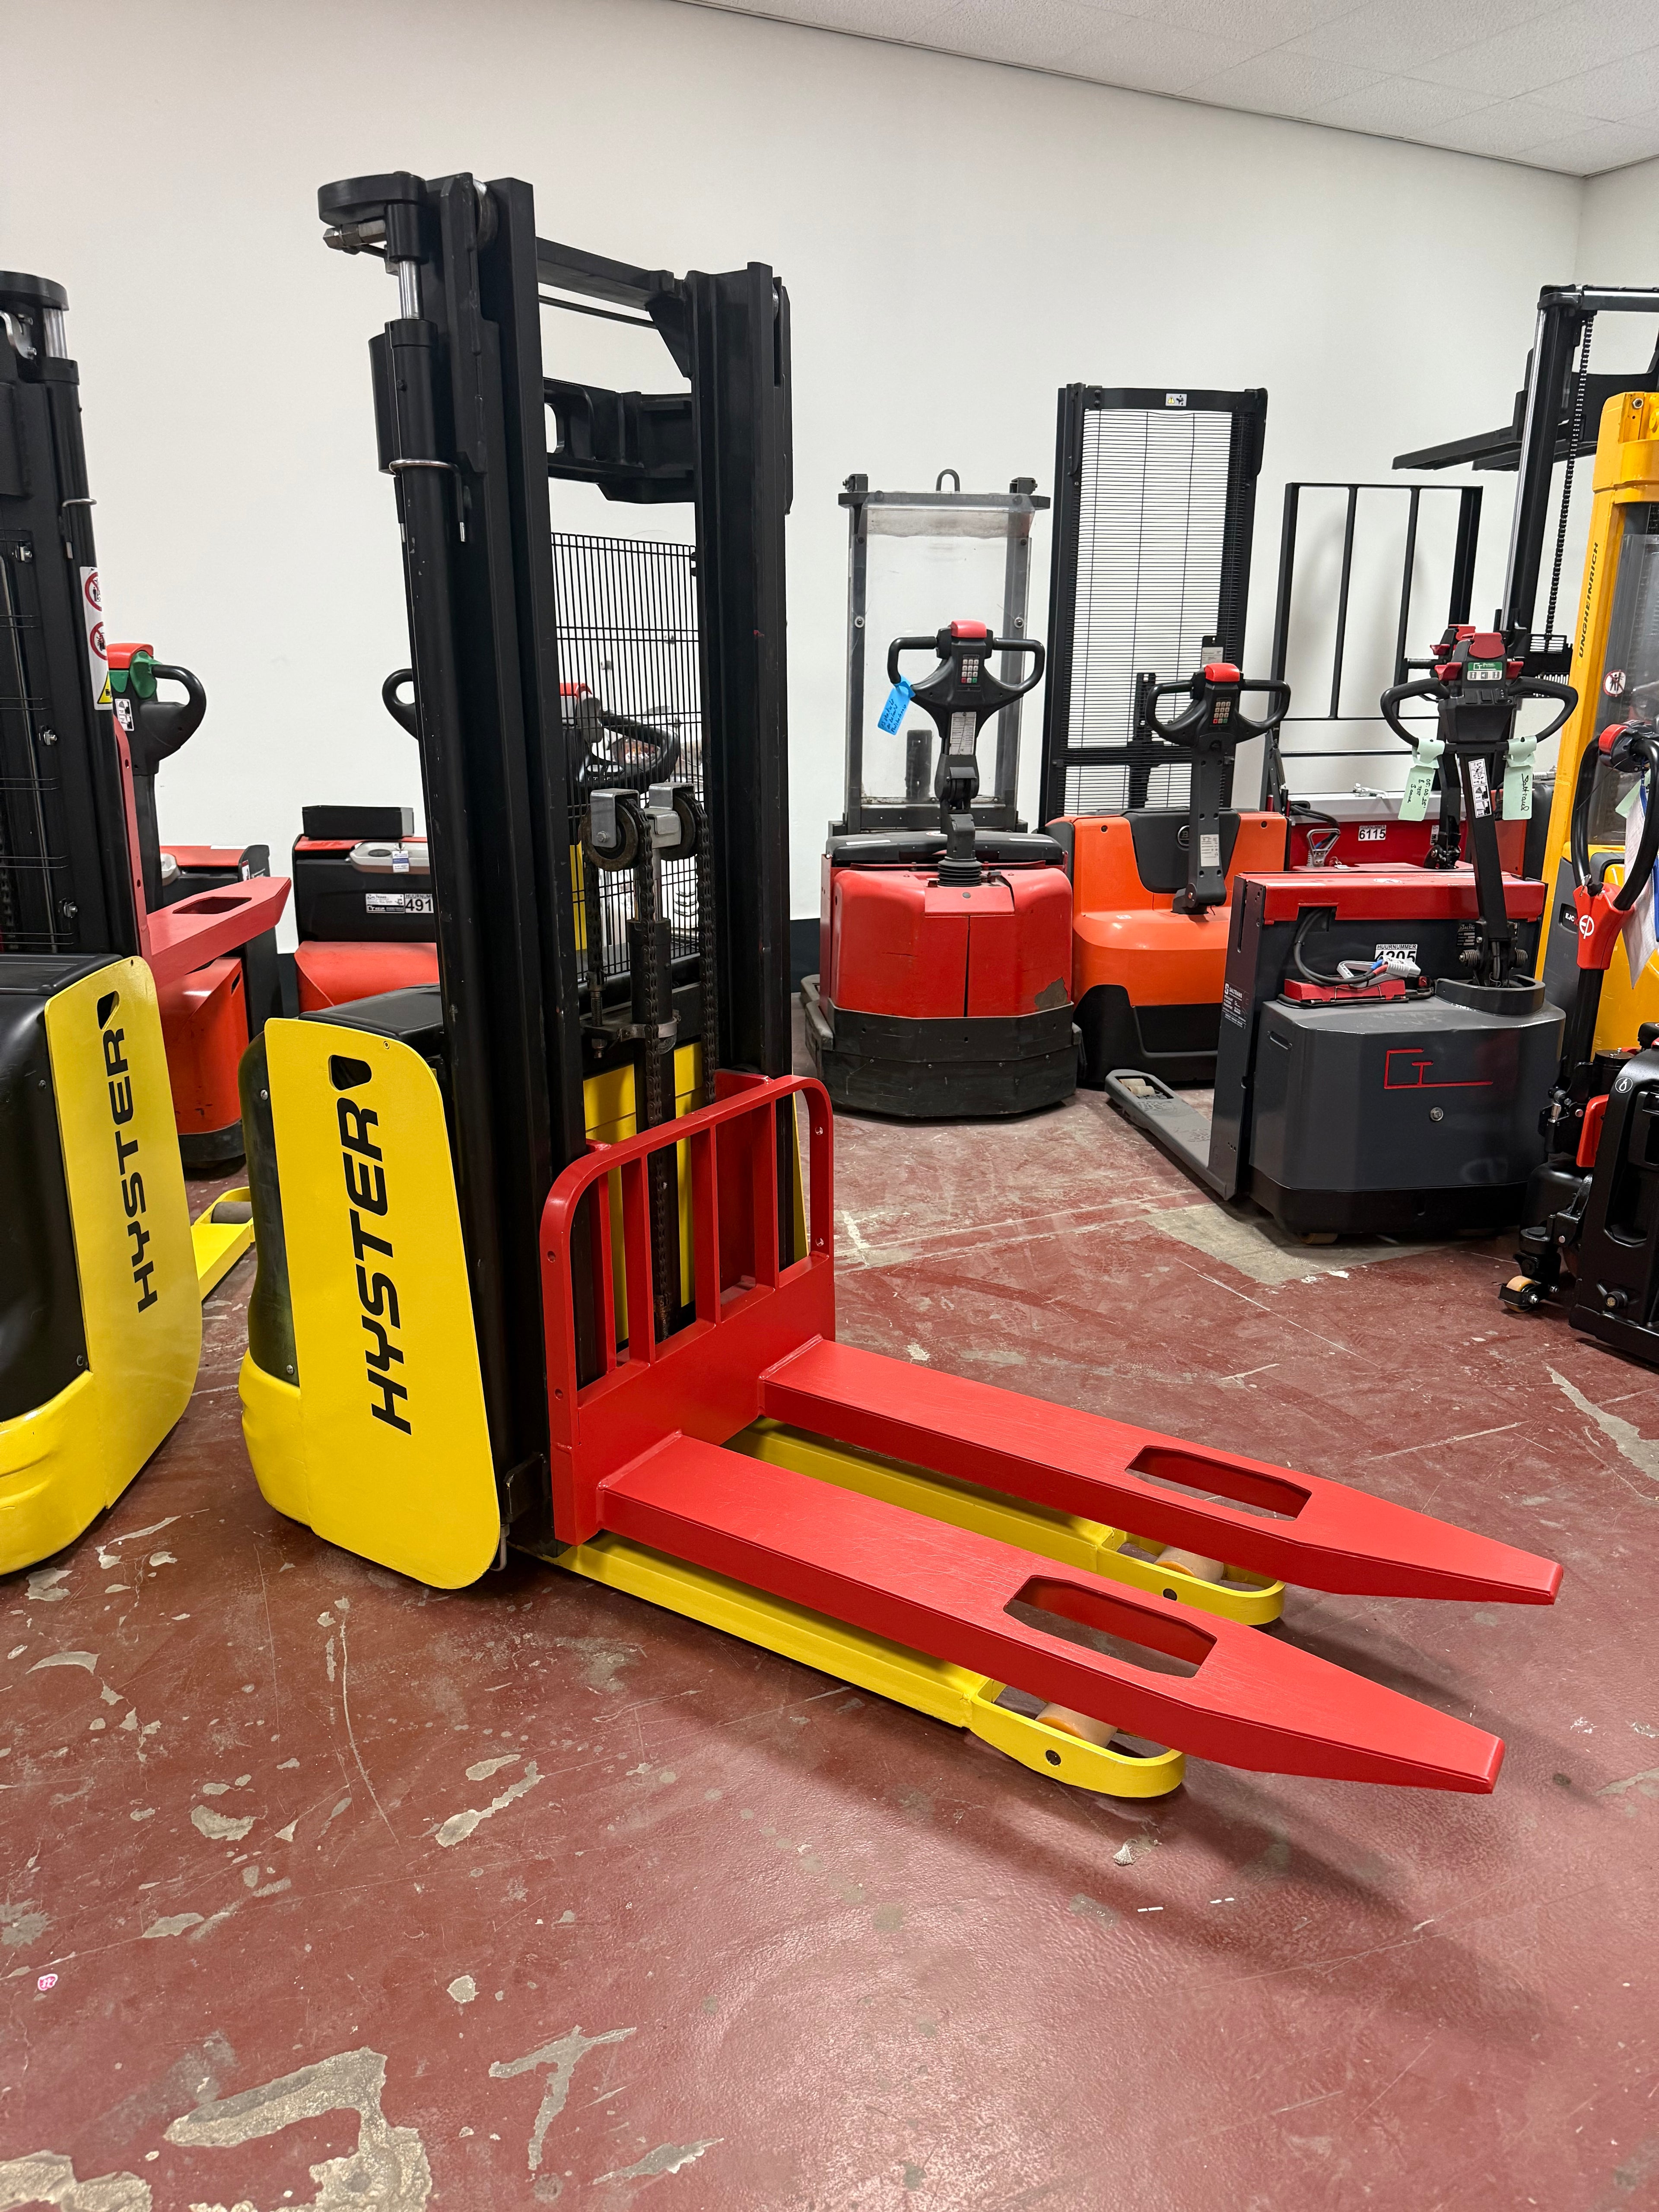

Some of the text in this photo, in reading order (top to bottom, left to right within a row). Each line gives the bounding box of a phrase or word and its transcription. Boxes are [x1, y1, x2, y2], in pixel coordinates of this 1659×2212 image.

[1359, 829, 1386, 839] 6115
[1565, 912, 1575, 922] EJC
[103, 1027, 158, 1313] HYSTER
[337, 1097, 411, 1436] HYSTER
